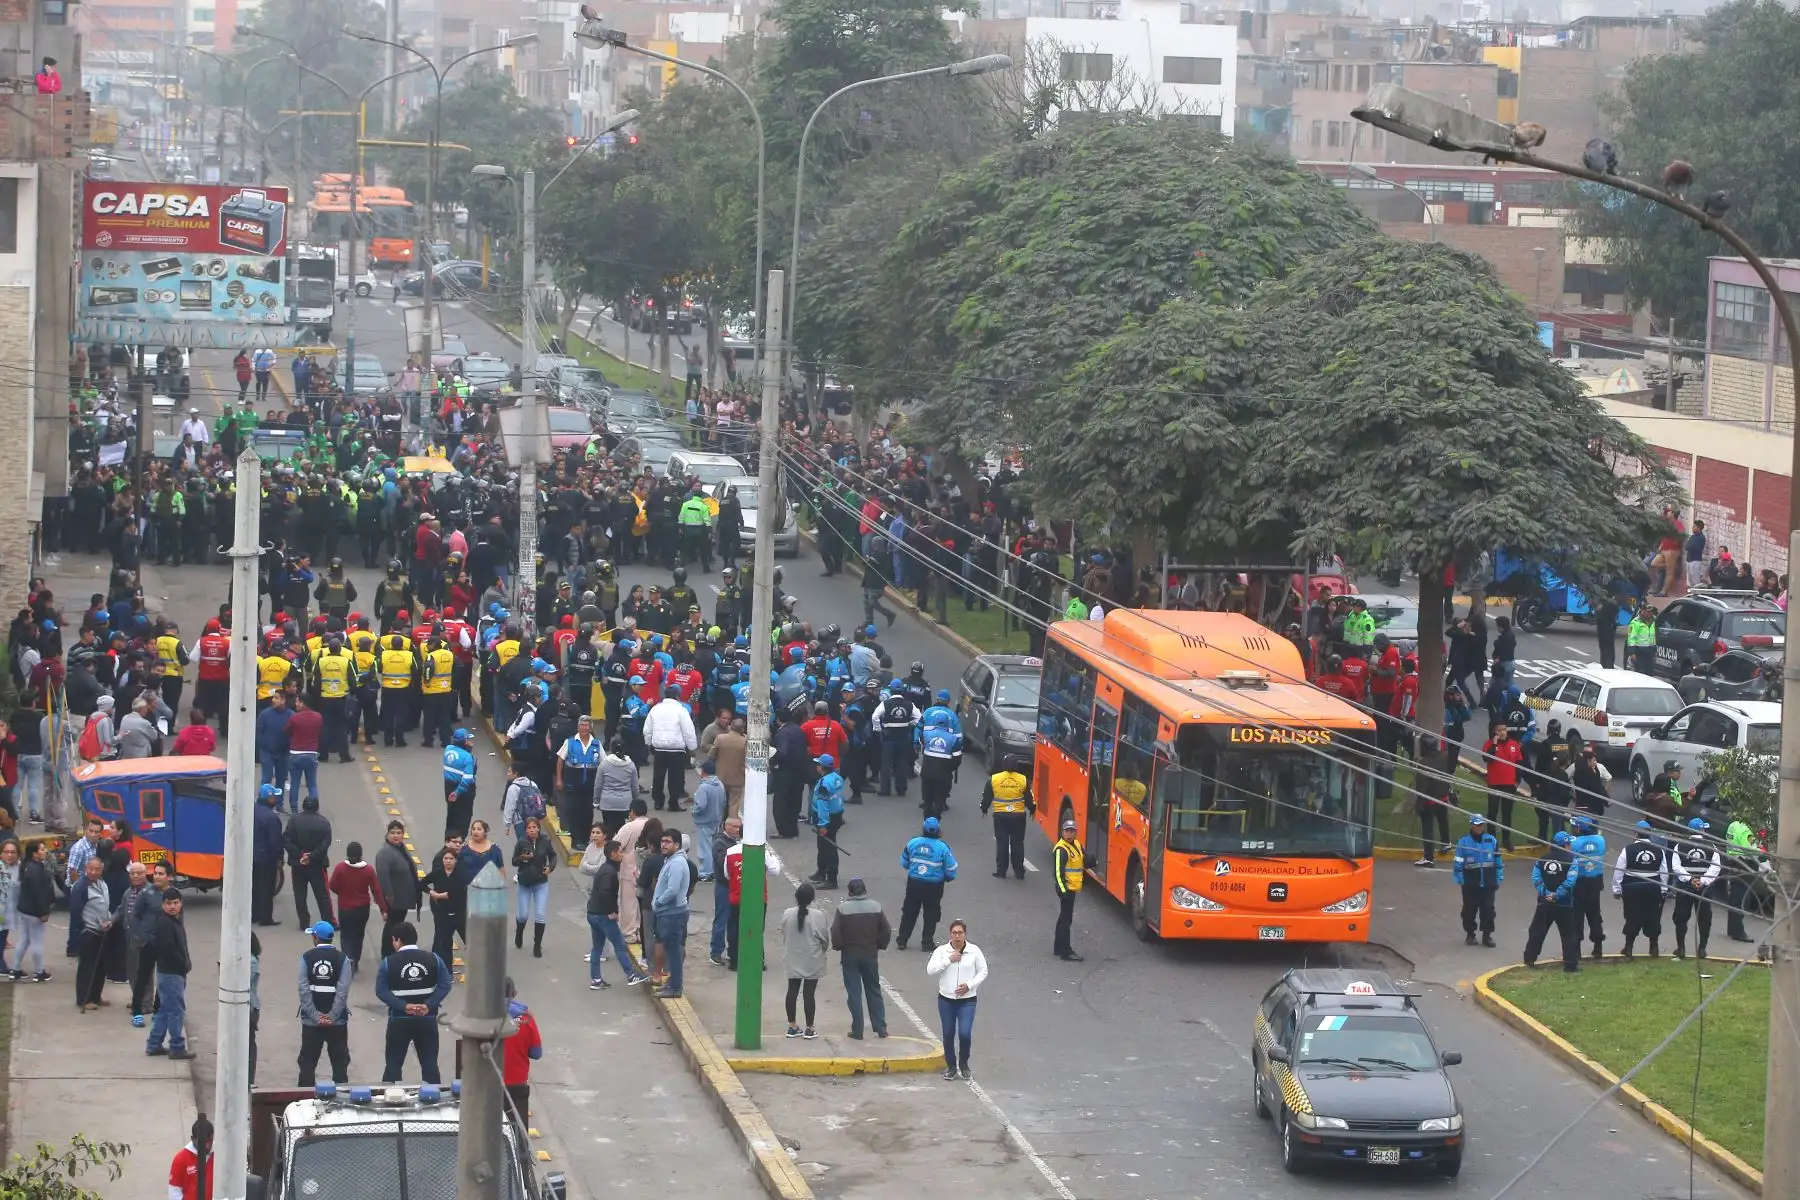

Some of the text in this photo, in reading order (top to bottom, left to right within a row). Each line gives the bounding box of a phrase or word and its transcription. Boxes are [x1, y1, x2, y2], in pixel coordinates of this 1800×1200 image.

[91, 192, 210, 217] CAPSA
[146, 219, 210, 229] PREMIUM
[227, 220, 264, 236] CAPSA
[75, 321, 217, 347] MURAMA
[1231, 728, 1332, 745] LOS ALISOS
[1316, 866, 1339, 875] LIMA
